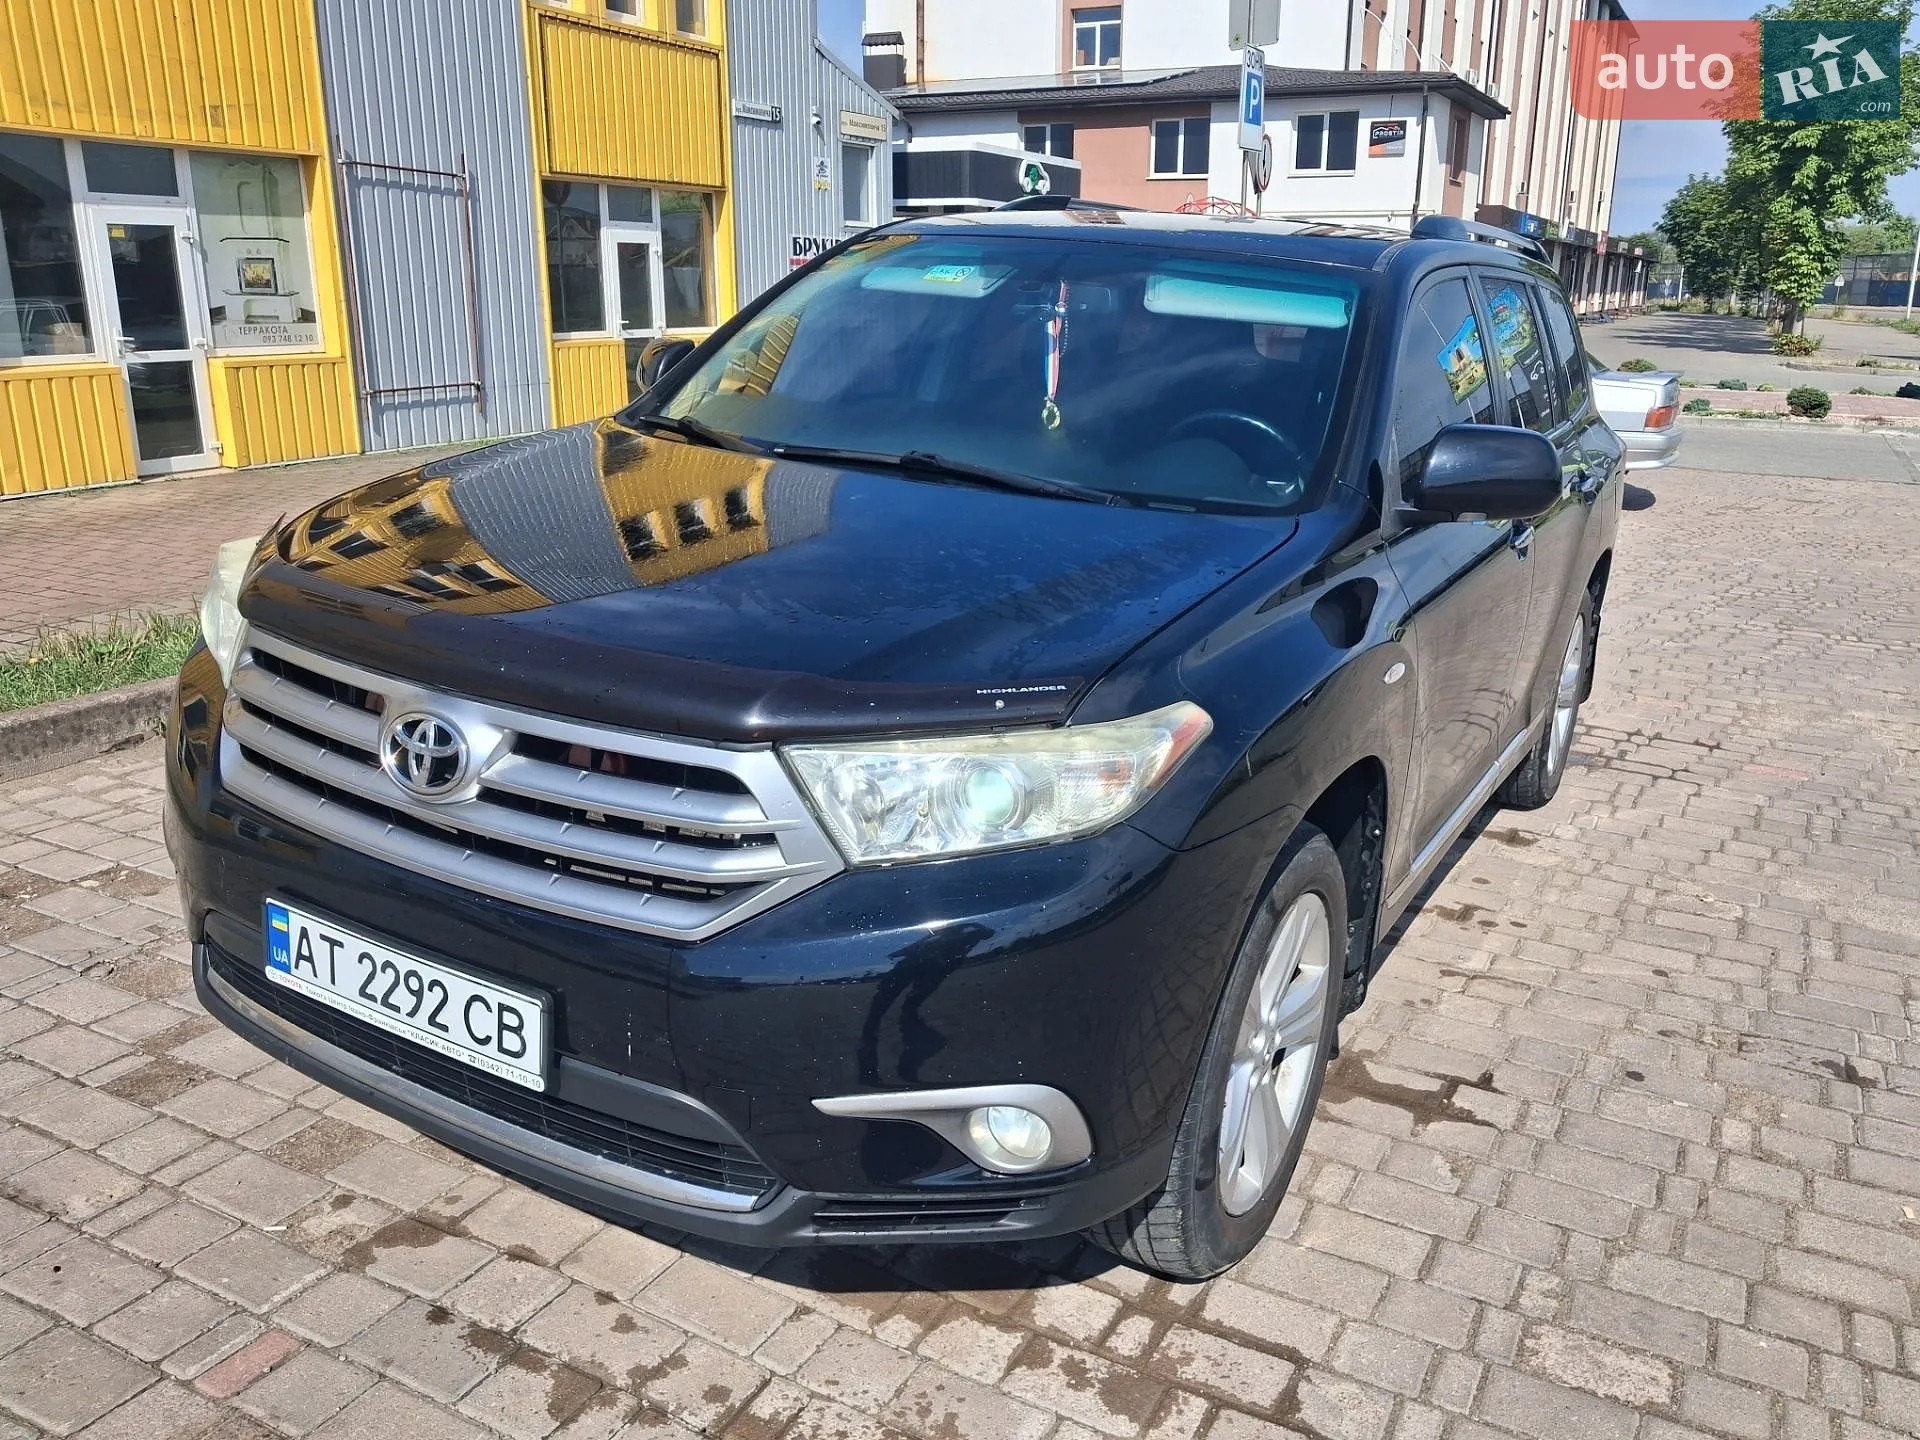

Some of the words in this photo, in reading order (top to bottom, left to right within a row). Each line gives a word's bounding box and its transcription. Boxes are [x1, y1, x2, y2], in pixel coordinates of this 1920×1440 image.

[771, 106, 781, 121] 15
[239, 325, 288, 335] ТЕРРАКОТА
[262, 335, 277, 344] 093
[279, 335, 292, 343] 748
[295, 334, 303, 343] 12
[305, 334, 314, 342] 10
[976, 685, 1067, 694] HIGHLANDER
[272, 945, 289, 966] UA
[294, 926, 344, 986] AT
[357, 951, 450, 1034] 2292
[463, 993, 528, 1060] CB
[505, 1068, 542, 1090] 71-10-10
